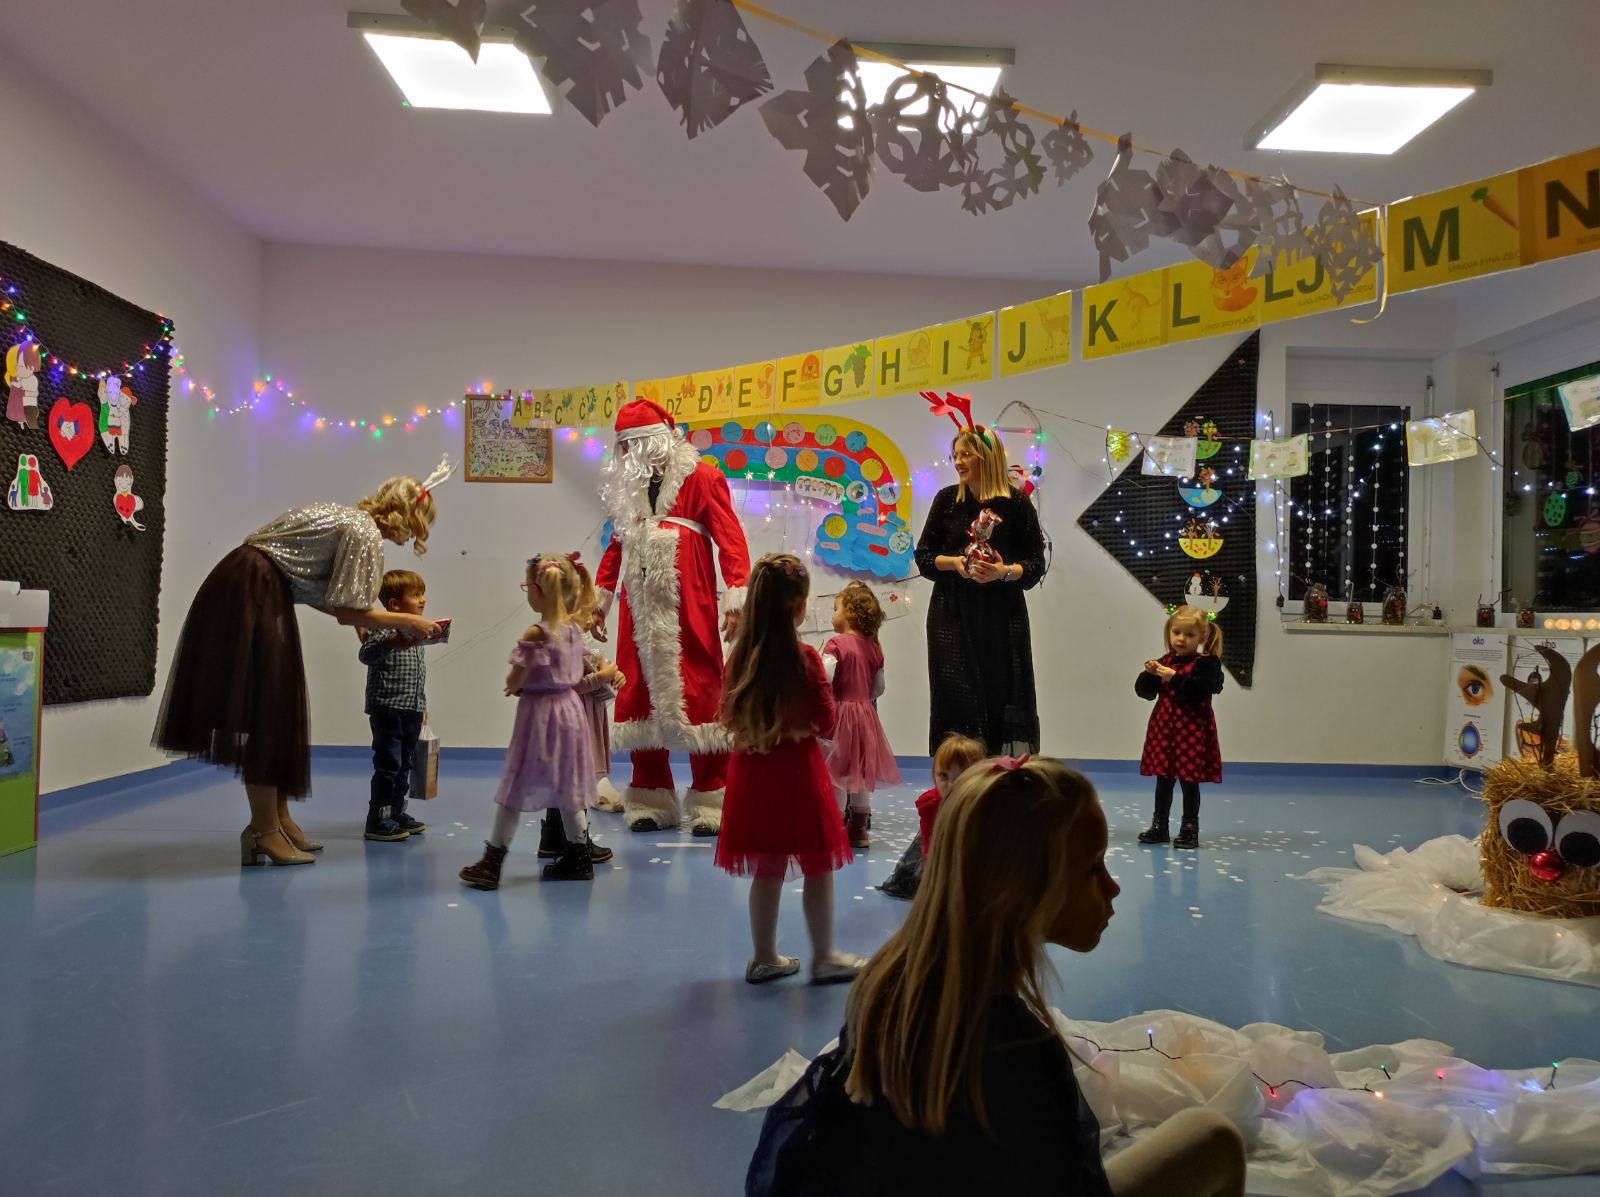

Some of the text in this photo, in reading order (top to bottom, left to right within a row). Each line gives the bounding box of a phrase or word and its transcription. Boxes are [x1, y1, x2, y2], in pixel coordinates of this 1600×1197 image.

[1545, 168, 1600, 239] N
[1403, 206, 1460, 272] M
[1264, 252, 1325, 303] LJ
[1172, 283, 1200, 328] L
[1088, 299, 1119, 347] K
[942, 340, 950, 375] I
[1007, 321, 1027, 363] J
[824, 364, 842, 397] G
[881, 348, 900, 385] H
[698, 385, 713, 413] Đ
[738, 378, 753, 408] E
[782, 370, 797, 402] F
[514, 396, 522, 417] A
[534, 401, 542, 419] B
[554, 406, 563, 425] C
[604, 390, 612, 418] Ć
[666, 393, 682, 415] DŽ
[1472, 636, 1485, 646] oko
